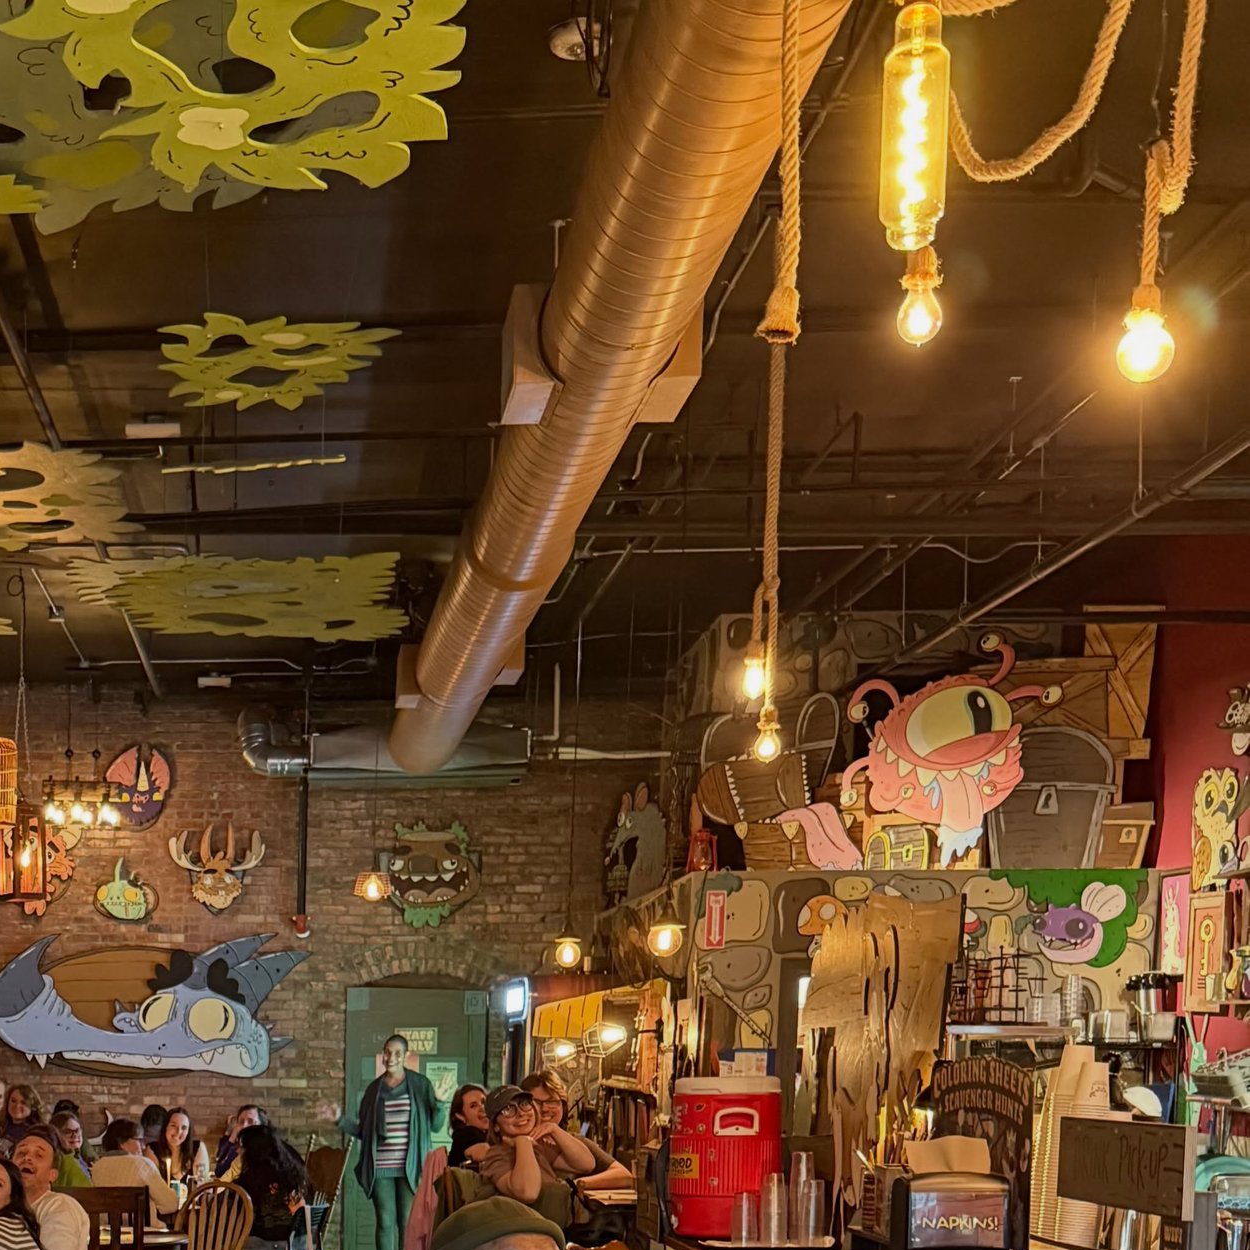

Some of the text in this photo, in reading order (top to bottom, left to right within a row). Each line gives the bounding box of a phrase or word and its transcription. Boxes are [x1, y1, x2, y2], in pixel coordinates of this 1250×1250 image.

[408, 1041, 434, 1051] NLY
[934, 1058, 1030, 1107] COLORING SHEETS
[944, 1088, 1024, 1125] SCAVENGER HUNTS
[921, 1216, 999, 1231] NAPKINS!
